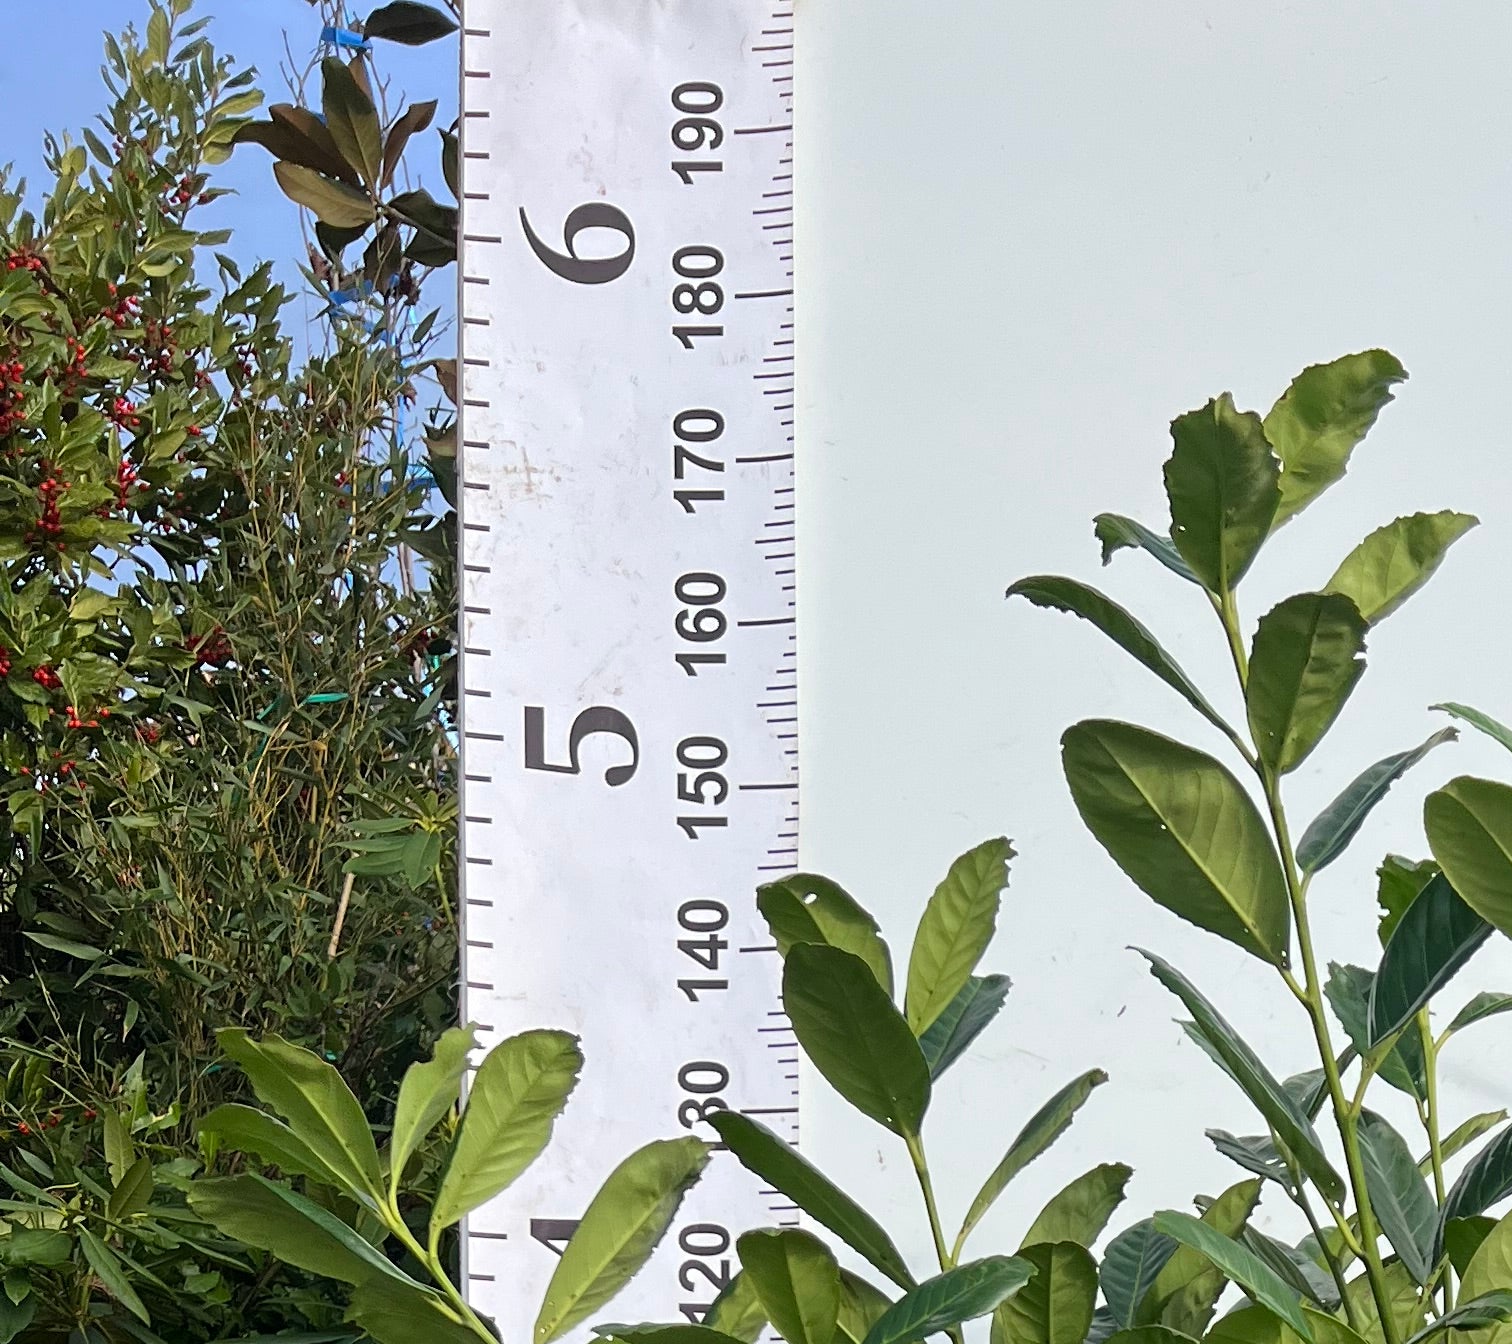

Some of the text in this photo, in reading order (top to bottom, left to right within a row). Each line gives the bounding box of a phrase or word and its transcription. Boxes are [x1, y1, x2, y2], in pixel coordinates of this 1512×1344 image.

[671, 82, 724, 185] 190
[519, 203, 636, 285] 6
[672, 245, 724, 350] 180
[673, 409, 725, 514] 170
[674, 572, 727, 677] 160
[524, 705, 639, 787] 5
[676, 736, 729, 840] 150
[677, 899, 729, 1002] 140
